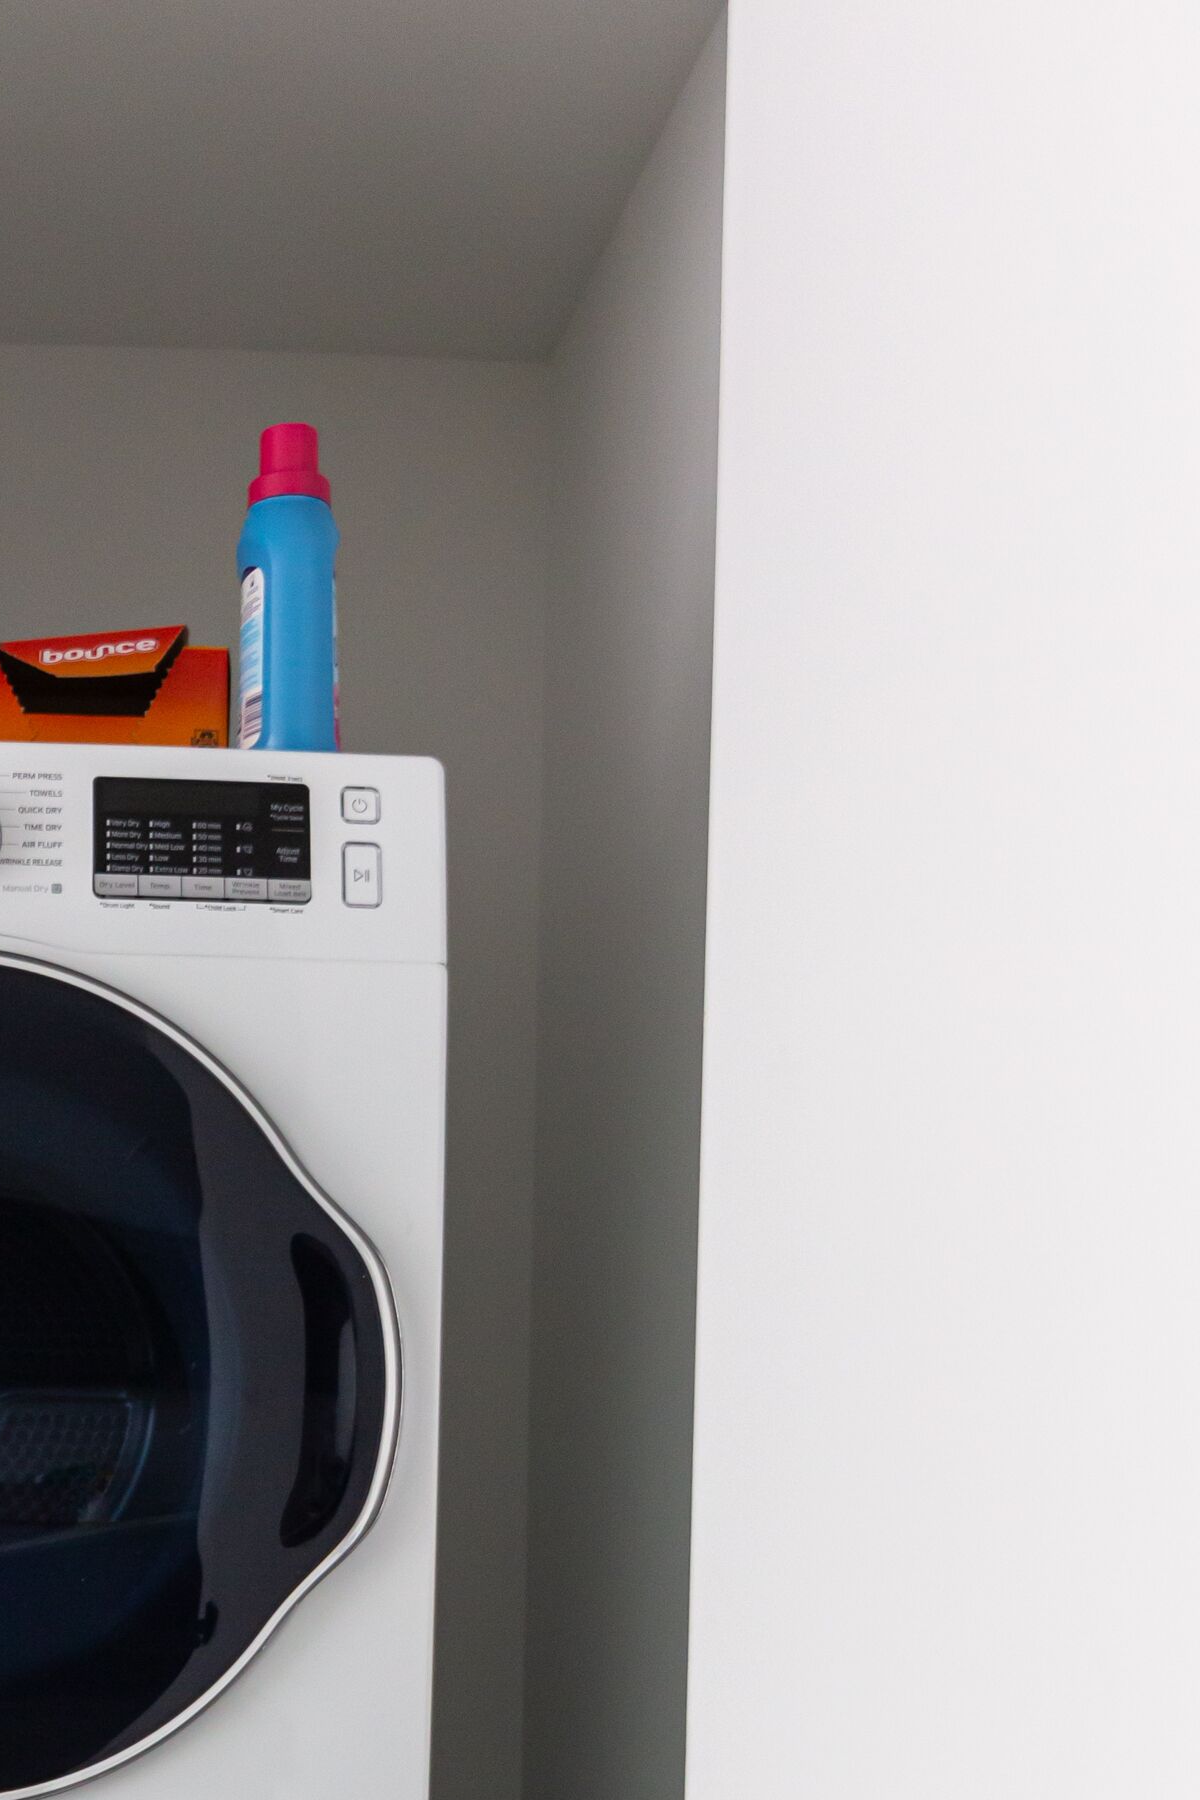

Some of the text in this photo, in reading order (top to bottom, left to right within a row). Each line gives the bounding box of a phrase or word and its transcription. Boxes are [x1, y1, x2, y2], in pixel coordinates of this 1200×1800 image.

[42, 639, 157, 664] bounce
[12, 772, 62, 780] PERM PRESS
[29, 789, 62, 798] TOWELS
[18, 806, 62, 814] QUICK DRY
[24, 823, 62, 831] TIME DRY
[154, 821, 171, 829] High
[21, 841, 62, 849] AIR FLUFF
[0, 858, 62, 867] WRINKLE RELEASE
[2, 884, 49, 894] Manual Dry
